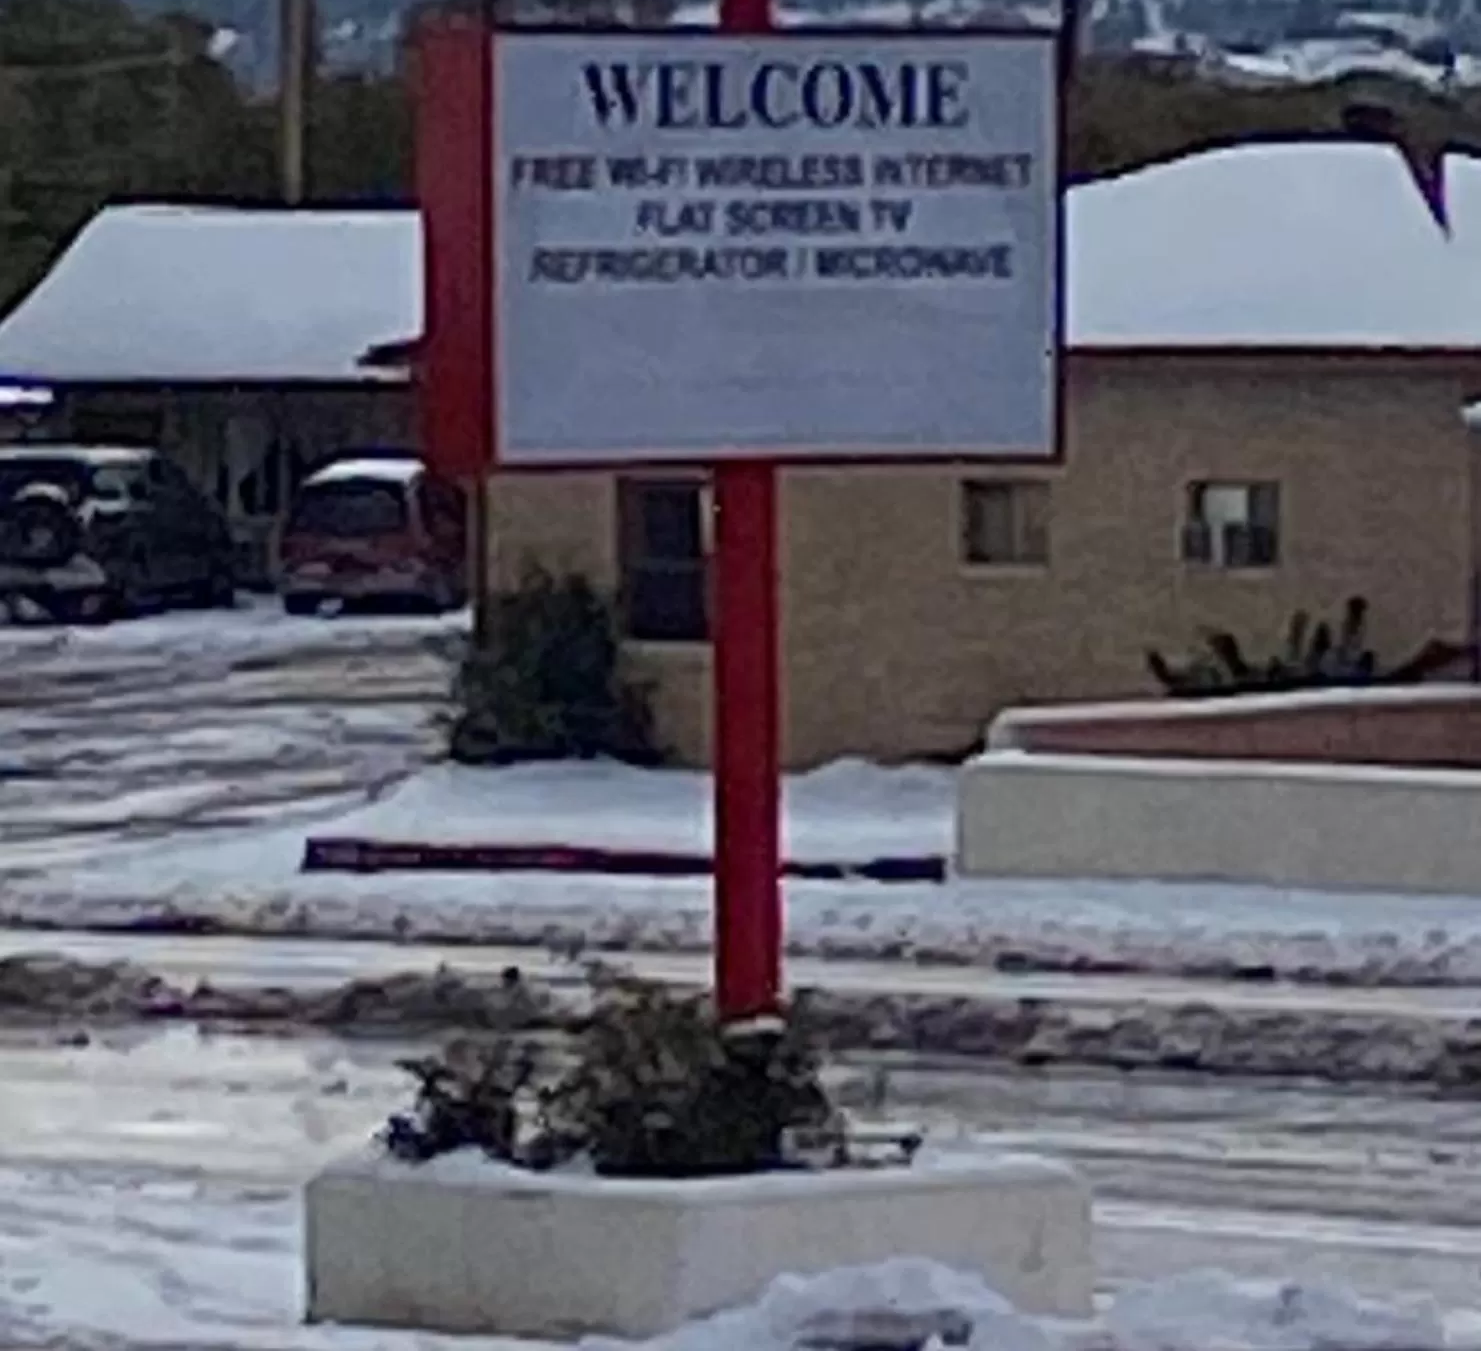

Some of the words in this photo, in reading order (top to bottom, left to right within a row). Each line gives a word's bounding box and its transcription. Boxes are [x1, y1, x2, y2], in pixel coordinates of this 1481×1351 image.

[581, 60, 970, 131] WELCOME
[511, 155, 595, 190] FREE
[606, 155, 687, 189] WI-FI
[696, 155, 864, 189] WIRELESS
[872, 153, 1033, 189] INTERNET
[635, 199, 714, 236] FLAT
[725, 199, 860, 236] SCREEN
[870, 198, 913, 235] TV
[528, 247, 789, 284] REFRIGERATOR
[816, 244, 1014, 281] MICROWAVE
